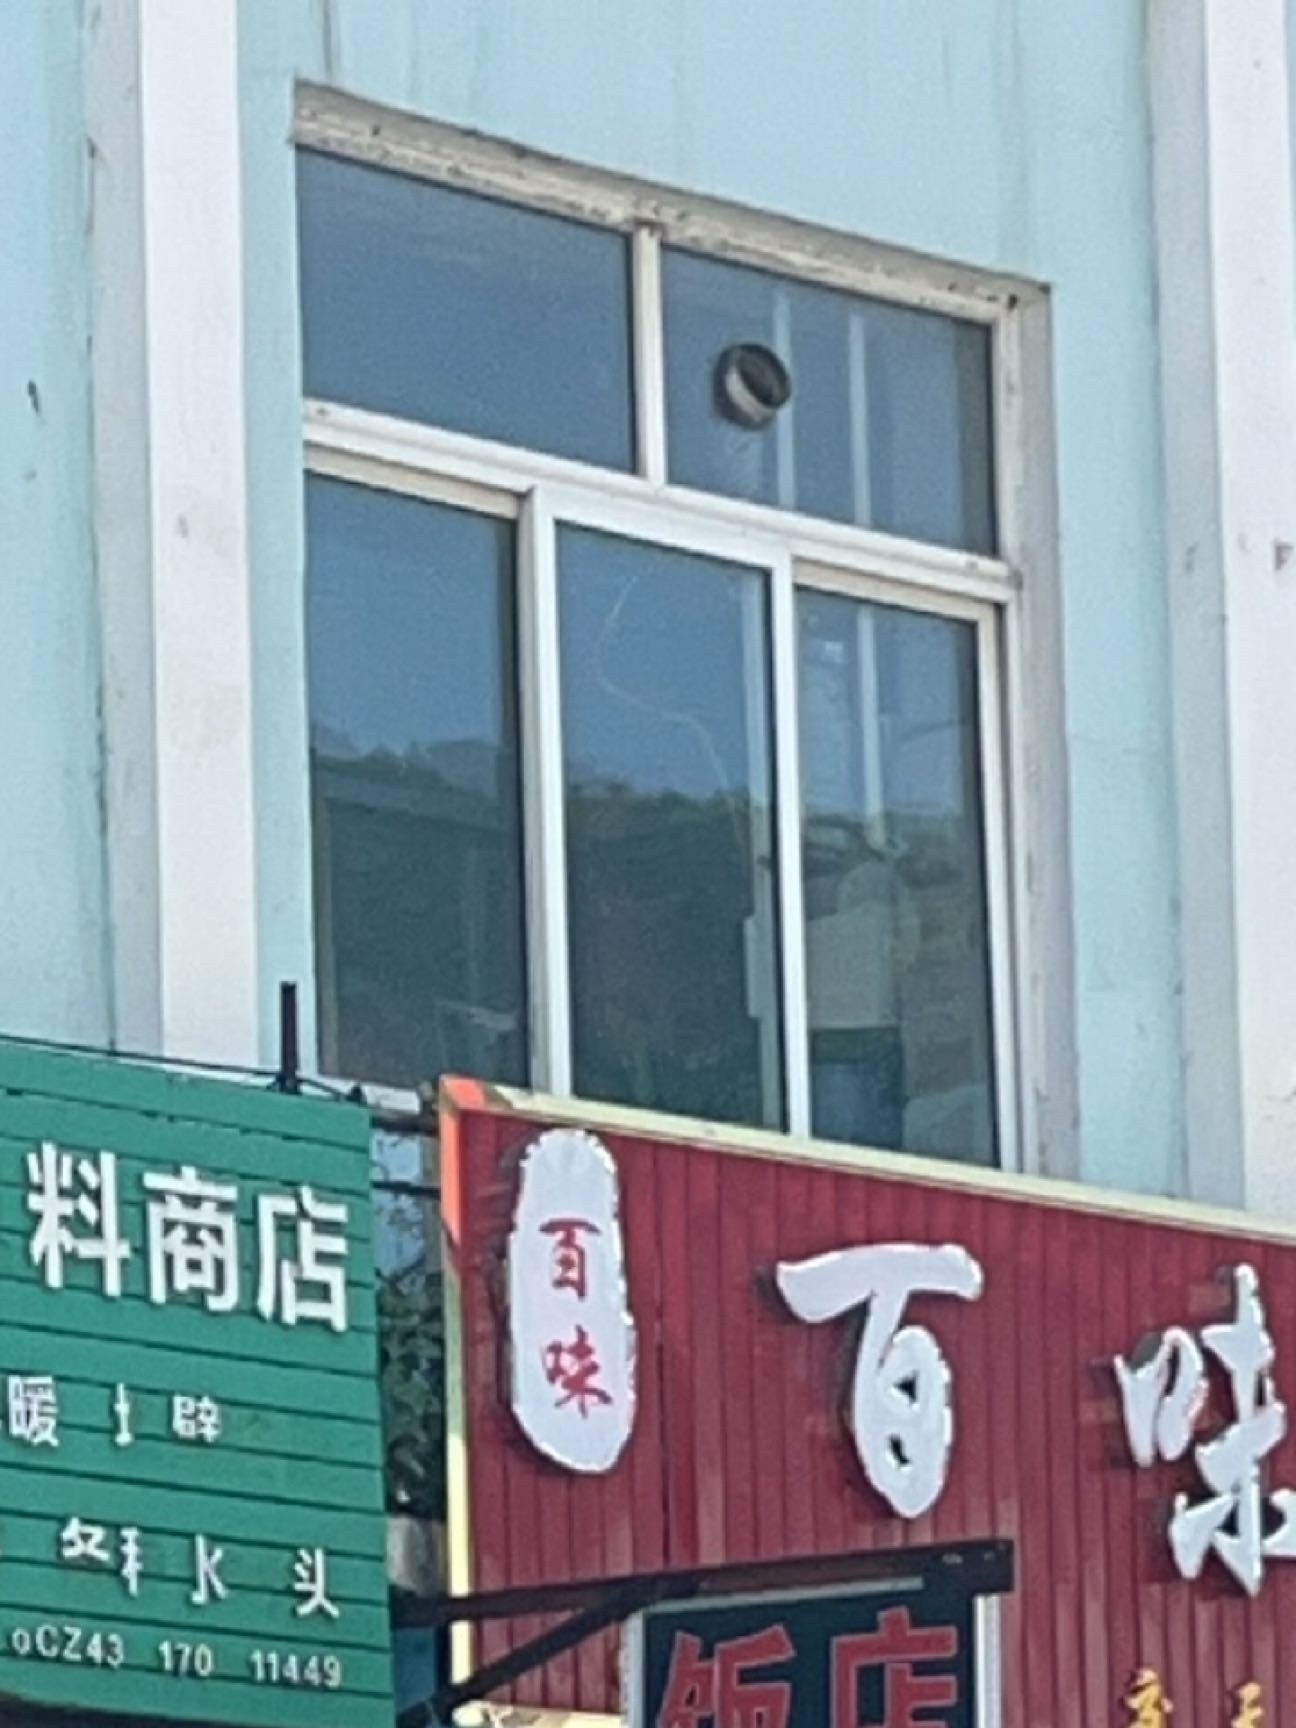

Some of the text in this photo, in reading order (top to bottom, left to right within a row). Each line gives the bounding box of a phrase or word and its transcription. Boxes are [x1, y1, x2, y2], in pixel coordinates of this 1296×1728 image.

[26, 1140, 352, 1334] 料商店
[540, 1218, 614, 1420] 百味
